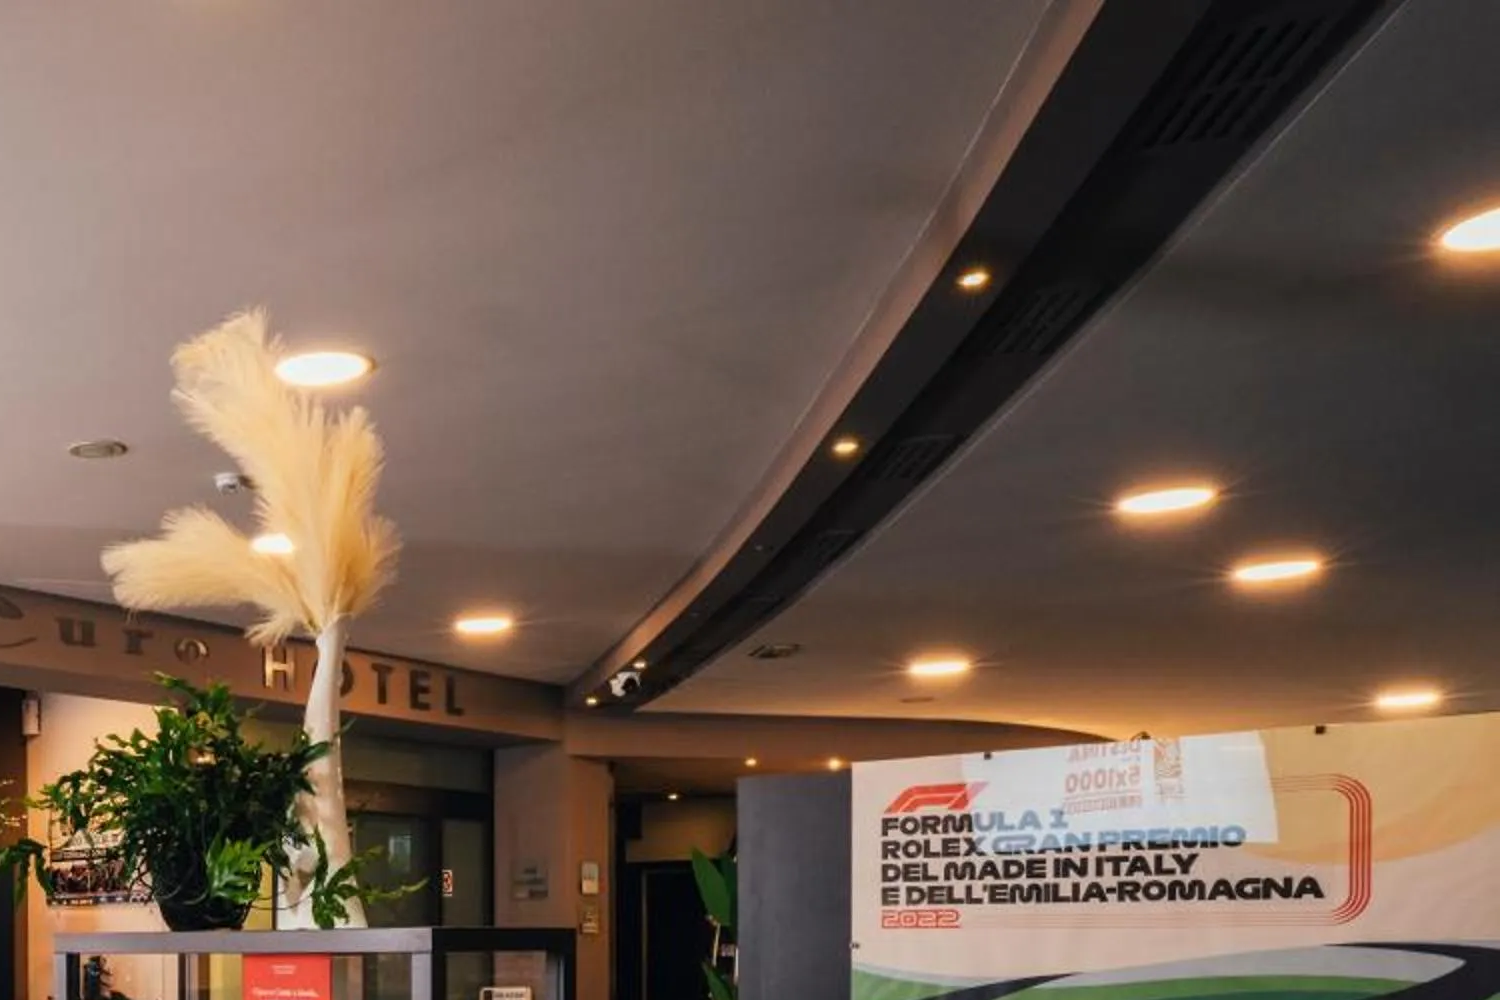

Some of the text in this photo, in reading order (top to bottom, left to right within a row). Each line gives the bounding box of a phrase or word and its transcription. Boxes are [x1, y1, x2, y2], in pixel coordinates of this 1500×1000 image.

[881, 809, 1042, 837] FORMULA
[881, 825, 1247, 861] ROLEX GRAN PREMIO
[881, 853, 1199, 883] DEL MADE IN ITALY
[881, 876, 1325, 906] E DELL'EMILIA-ROMAGNA
[881, 909, 962, 929] 2022
